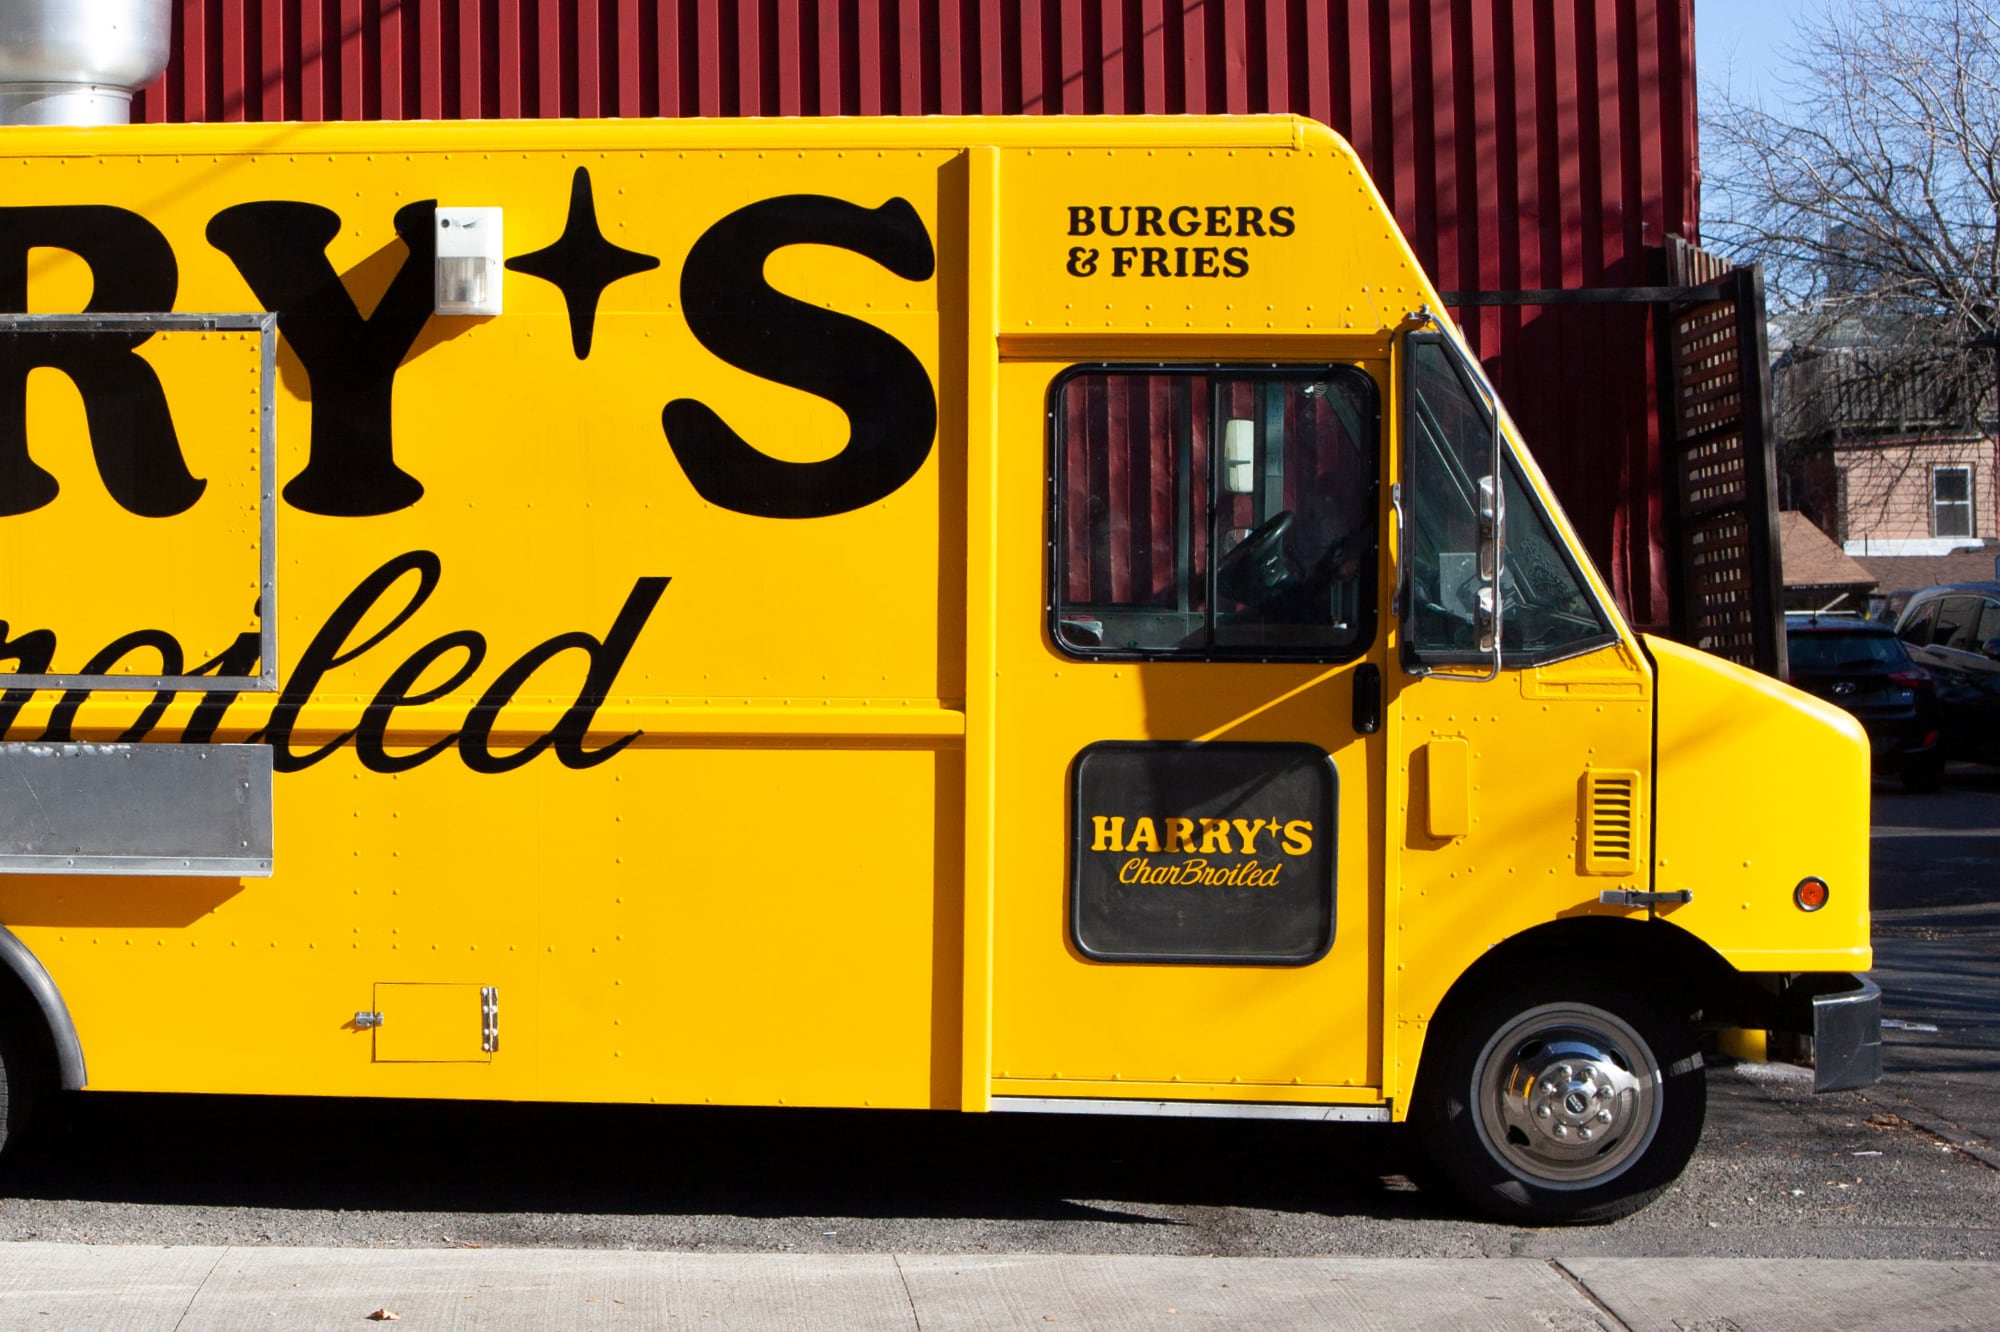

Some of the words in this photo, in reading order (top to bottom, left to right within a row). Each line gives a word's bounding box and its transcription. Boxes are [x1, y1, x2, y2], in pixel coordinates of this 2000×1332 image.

[1068, 206, 1295, 237] BURGERS
[1067, 247, 1099, 277] &
[1111, 246, 1249, 278] FRIES
[1091, 816, 1313, 855] HARRY'S
[1119, 858, 1282, 887] CharBroiled
